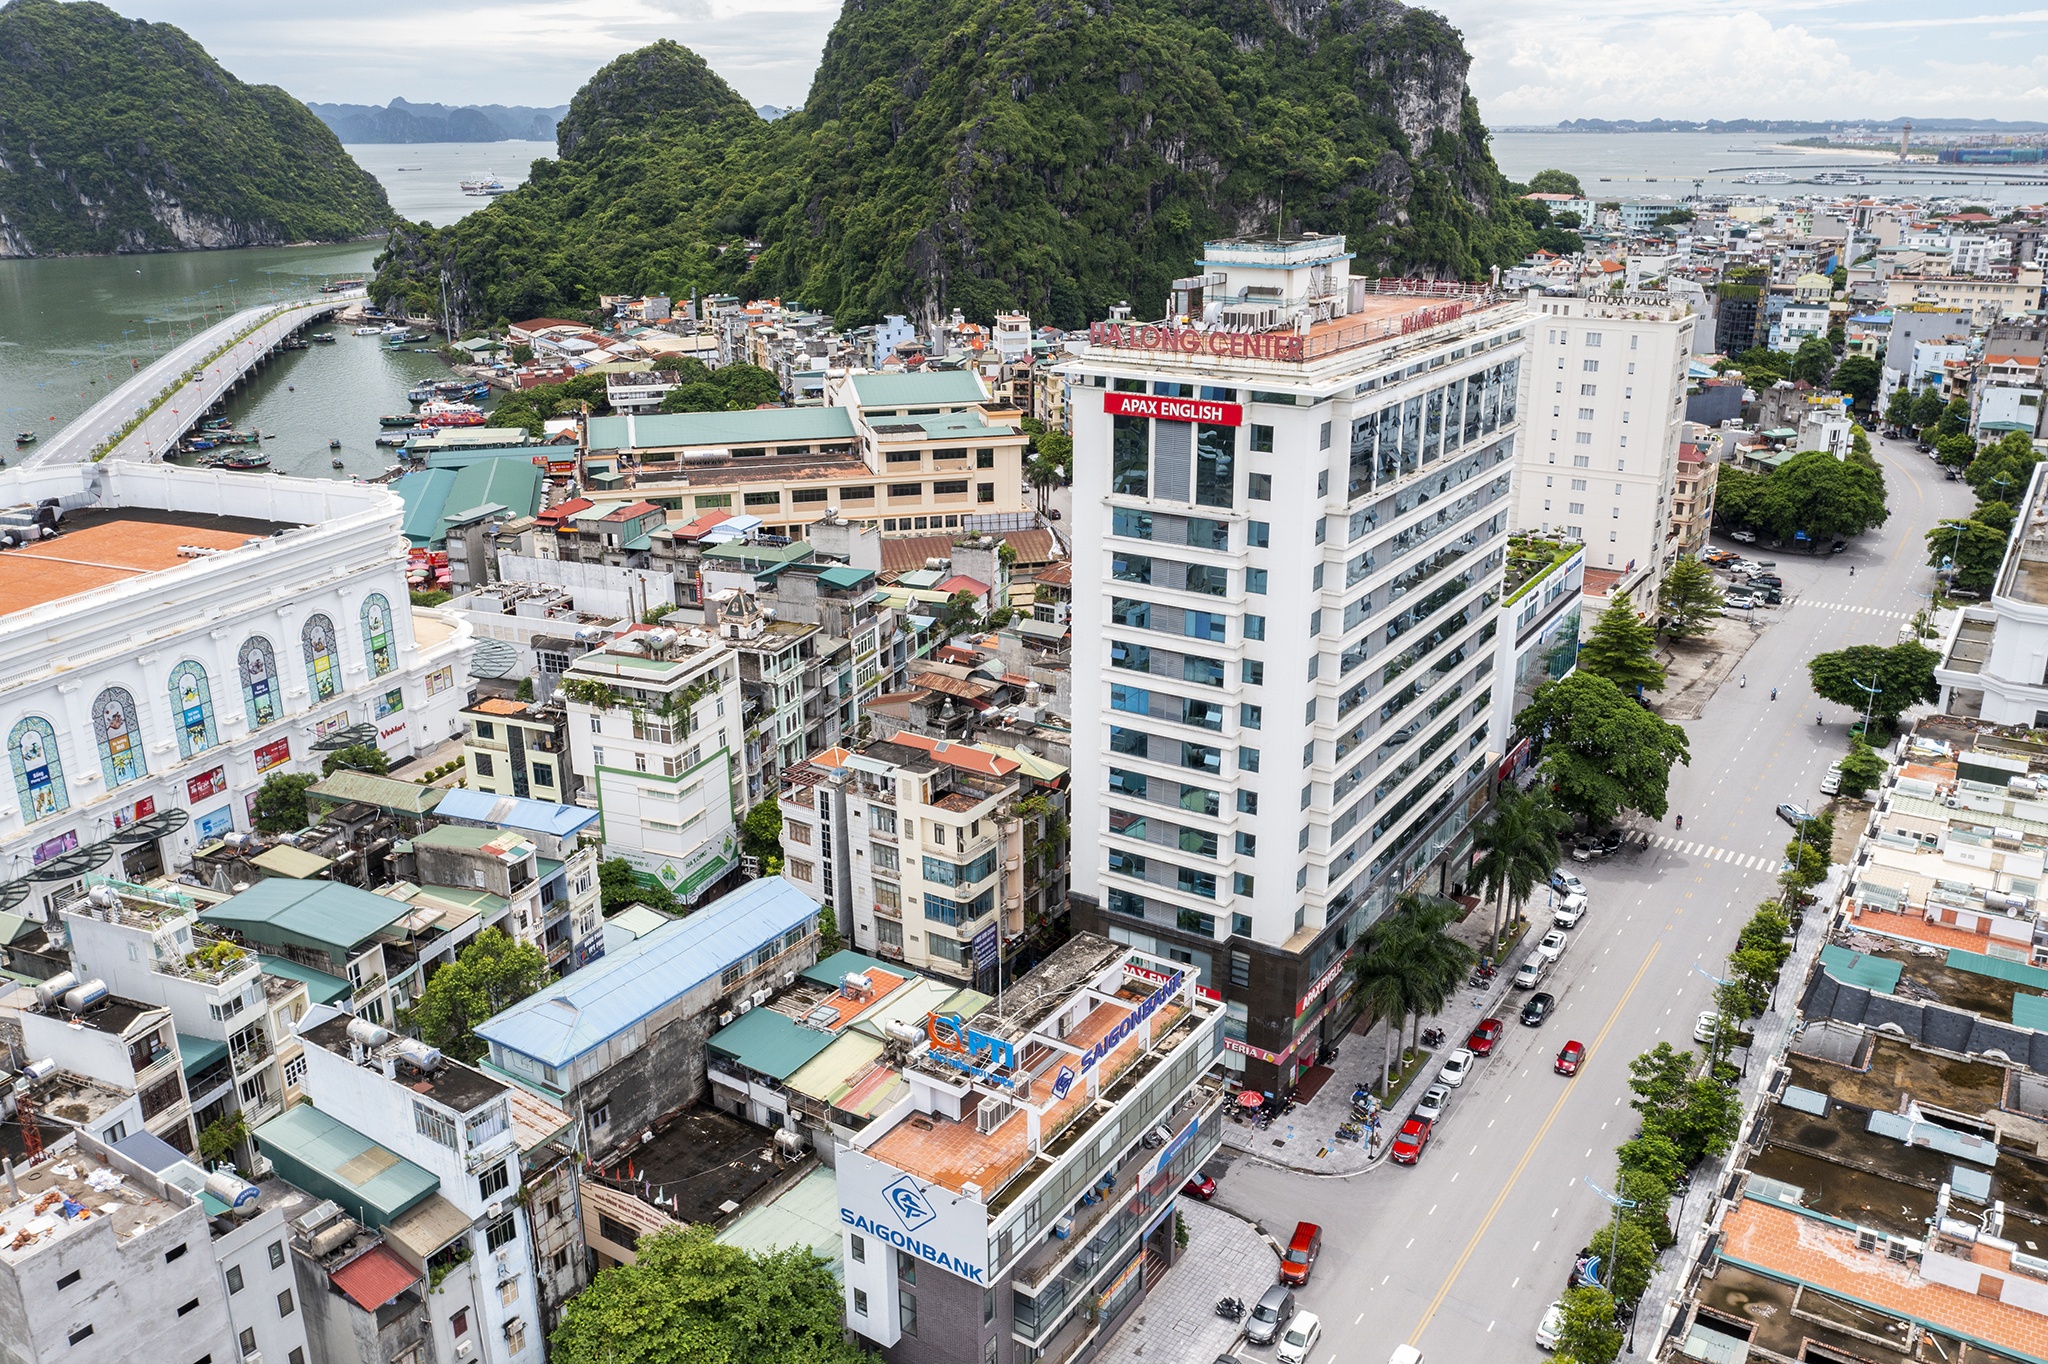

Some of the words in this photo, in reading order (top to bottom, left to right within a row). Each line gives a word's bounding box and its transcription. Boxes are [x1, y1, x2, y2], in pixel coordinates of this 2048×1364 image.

[1588, 294, 1611, 304] CITY
[1613, 295, 1632, 305] BAY
[1634, 297, 1671, 307] PALACE
[1090, 322, 1123, 346] HA
[1129, 325, 1199, 352] LONG
[1209, 331, 1303, 360] CENTER
[1121, 398, 1158, 415] APAX
[1160, 402, 1223, 421] ENGLISH
[381, 722, 406, 739] VinMart
[202, 820, 213, 834] 5
[1122, 965, 1145, 977] PAX
[1302, 982, 1321, 1011] APAX
[1081, 970, 1183, 1075] SAIGONBANK
[968, 1028, 1013, 1068] PTI
[1224, 1040, 1258, 1057] TERIA
[840, 1207, 984, 1284] SAIGONBANK
